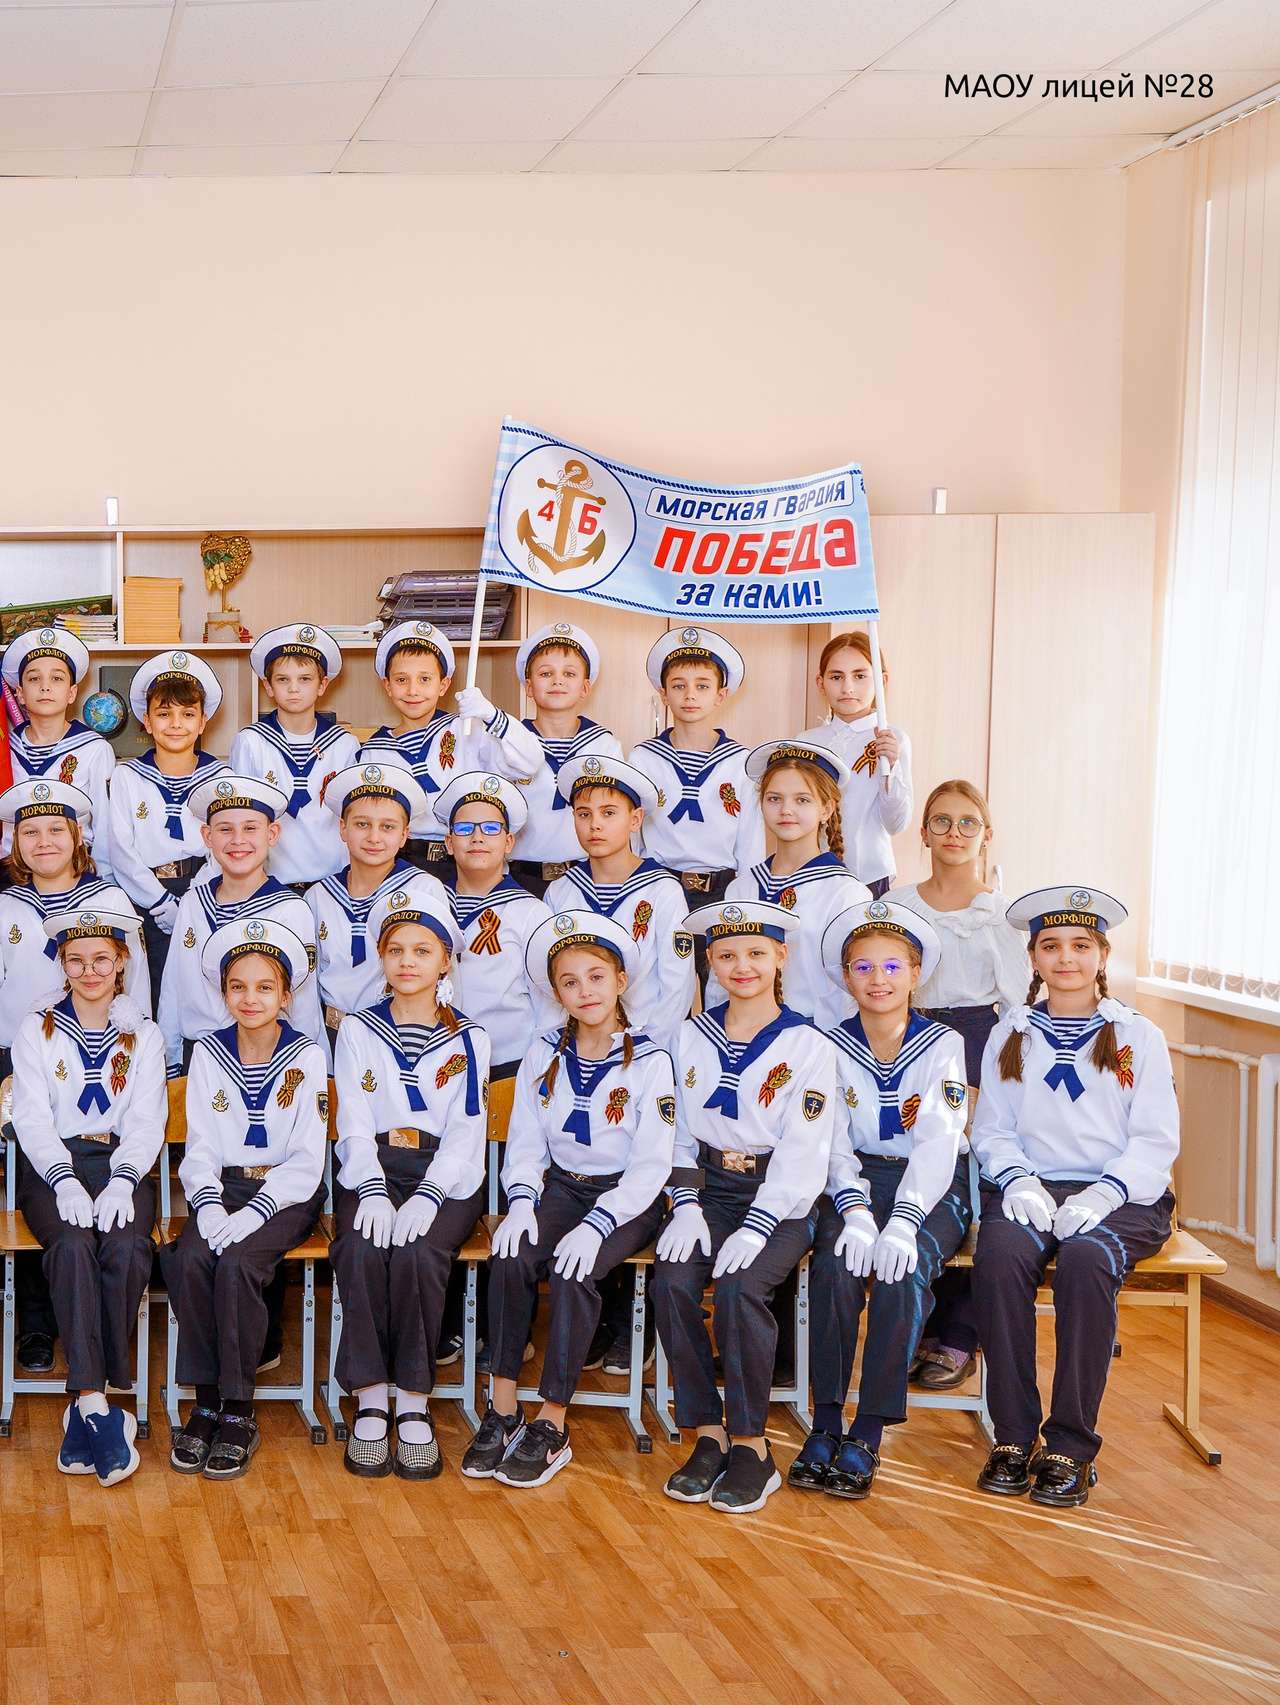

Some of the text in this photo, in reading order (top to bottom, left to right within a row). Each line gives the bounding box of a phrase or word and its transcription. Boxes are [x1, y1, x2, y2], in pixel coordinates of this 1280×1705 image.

[537, 499, 602, 535] 4 Б
[399, 638, 441, 655] МОРФЛОТ
[538, 638, 581, 650] МОРФЛОТ
[27, 650, 68, 661] МОРФЛОТ
[282, 645, 322, 660] МОРФЛОТ
[667, 648, 711, 662] МОРФЛОТ
[156, 672, 199, 686] МОРФЛОТ
[770, 751, 817, 763] МОРФЛОТ
[574, 778, 617, 790] МОРФЛОТ
[350, 786, 395, 799] МОРФЛОТ
[21, 806, 64, 817] МОРФЛОТ
[210, 798, 252, 813] МОРФЛОТ
[1043, 914, 1097, 927] МОРФЛОТ
[66, 926, 113, 939] МОРФЛОТ
[711, 922, 762, 936] МОРФЛОТ
[853, 922, 906, 937] МОРФЛОТ
[230, 944, 281, 957] МОРФЛОТ
[548, 934, 596, 958] МОРФЛОТ
